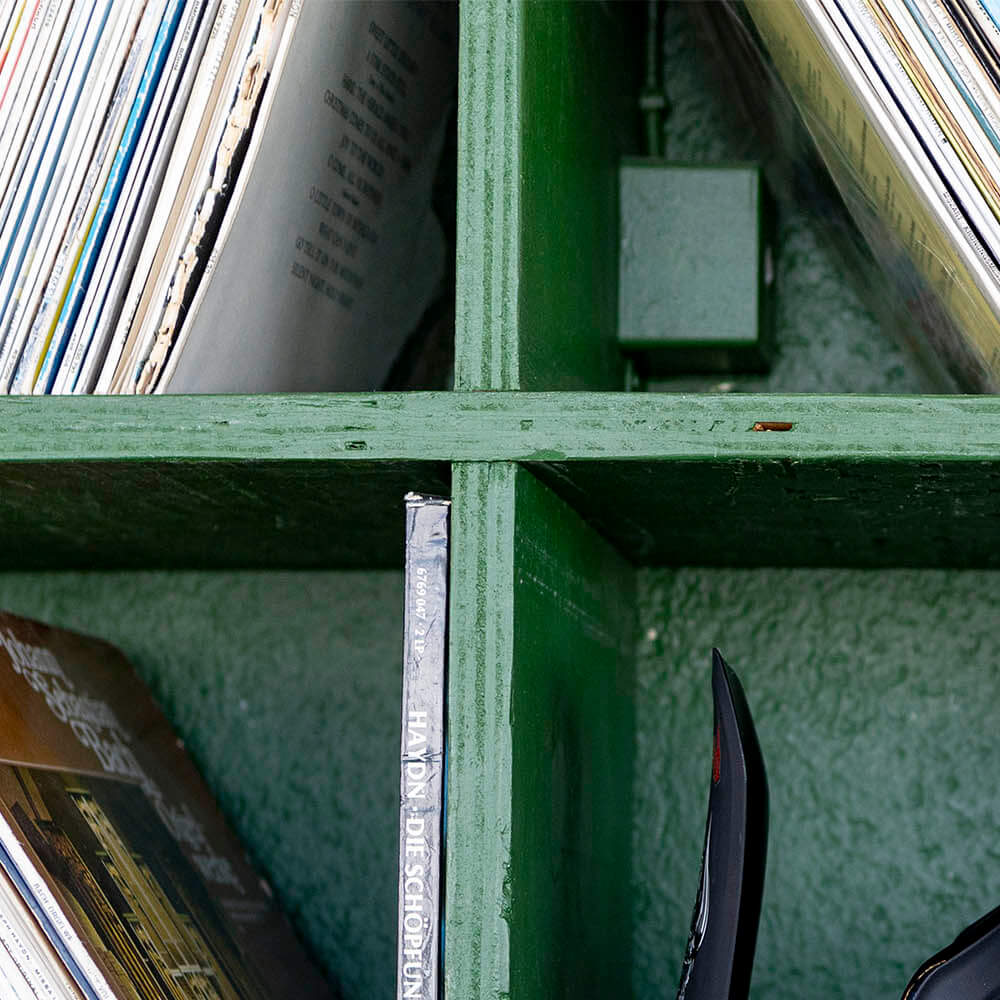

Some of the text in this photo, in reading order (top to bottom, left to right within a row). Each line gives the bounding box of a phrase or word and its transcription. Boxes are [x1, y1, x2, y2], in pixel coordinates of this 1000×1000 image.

[415, 567, 428, 596] 6769
[414, 599, 427, 620] 047
[406, 711, 428, 800] HAYDN
[404, 815, 426, 857] DIE
